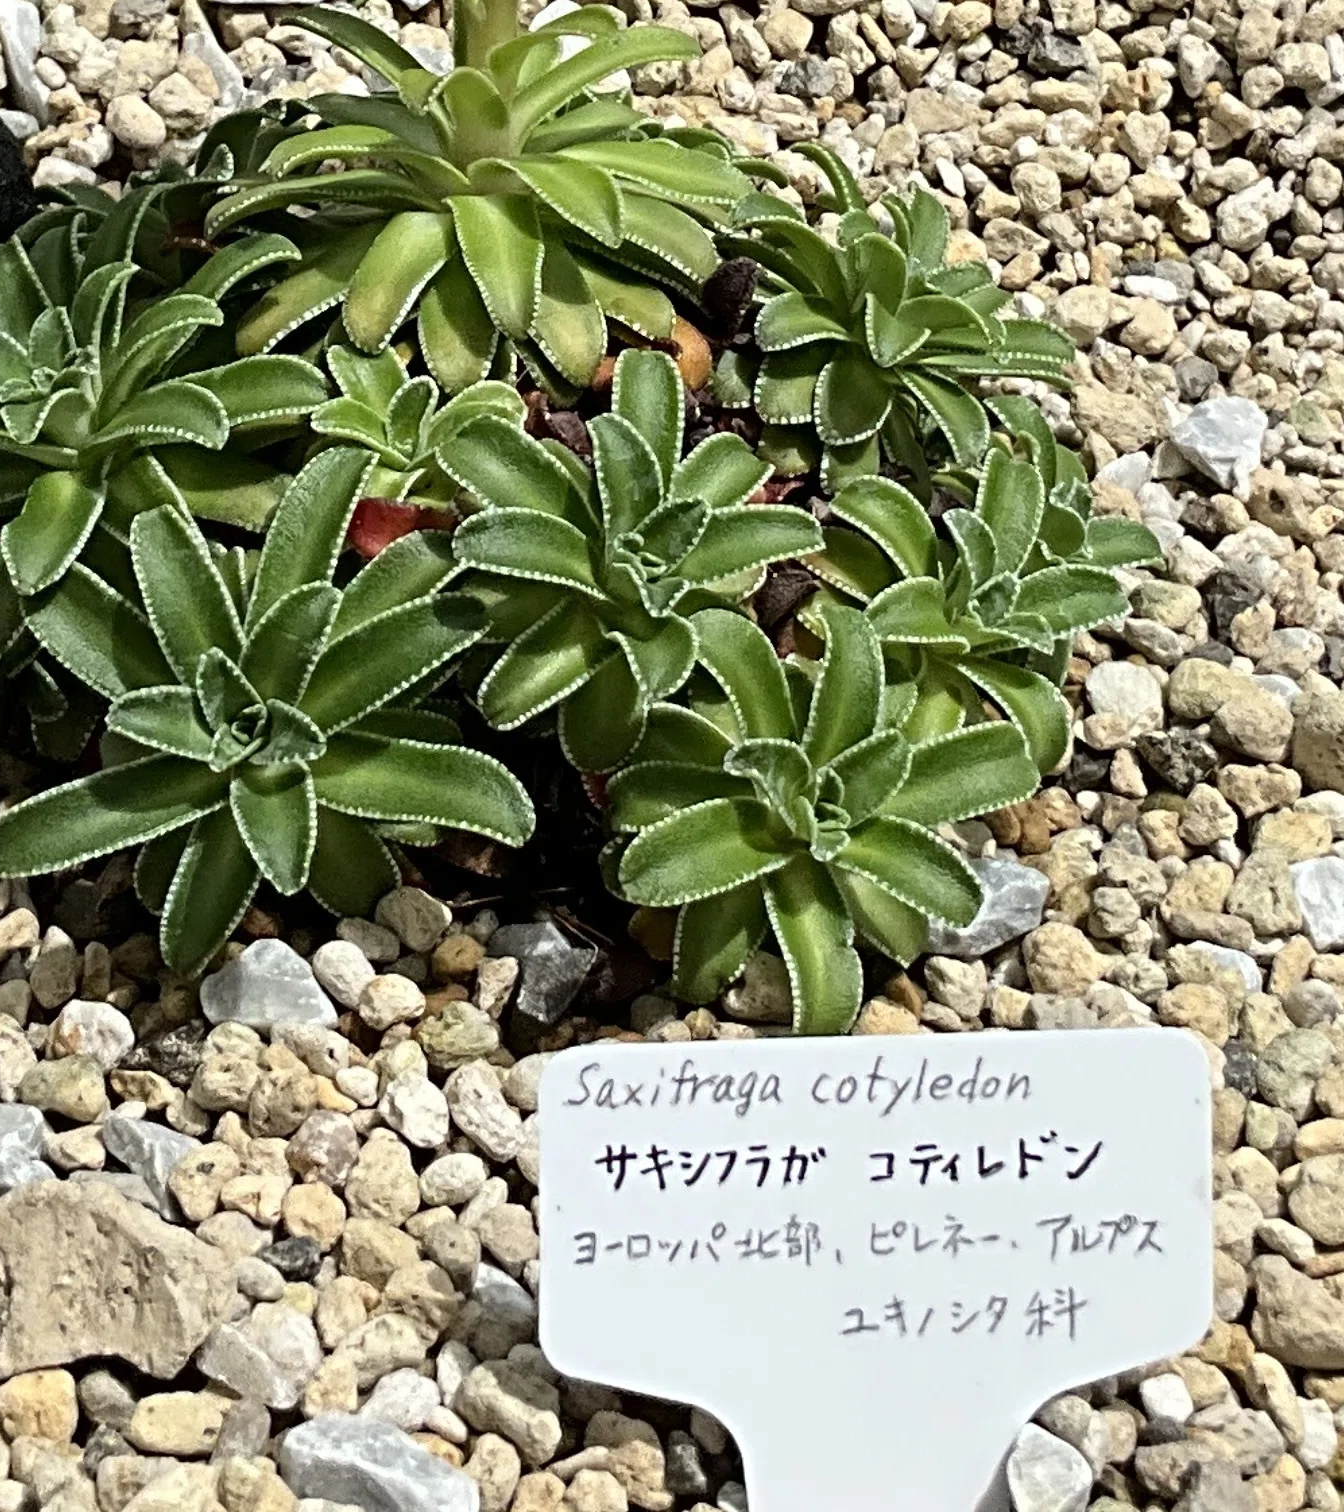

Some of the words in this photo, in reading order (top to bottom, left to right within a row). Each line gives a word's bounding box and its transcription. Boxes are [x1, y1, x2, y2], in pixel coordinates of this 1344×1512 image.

[563, 1059, 783, 1117] Saxifraga
[811, 1056, 1032, 1118] cotyledon
[594, 1144, 828, 1192] サキシフラガ
[869, 1130, 1105, 1186] コティレドン
